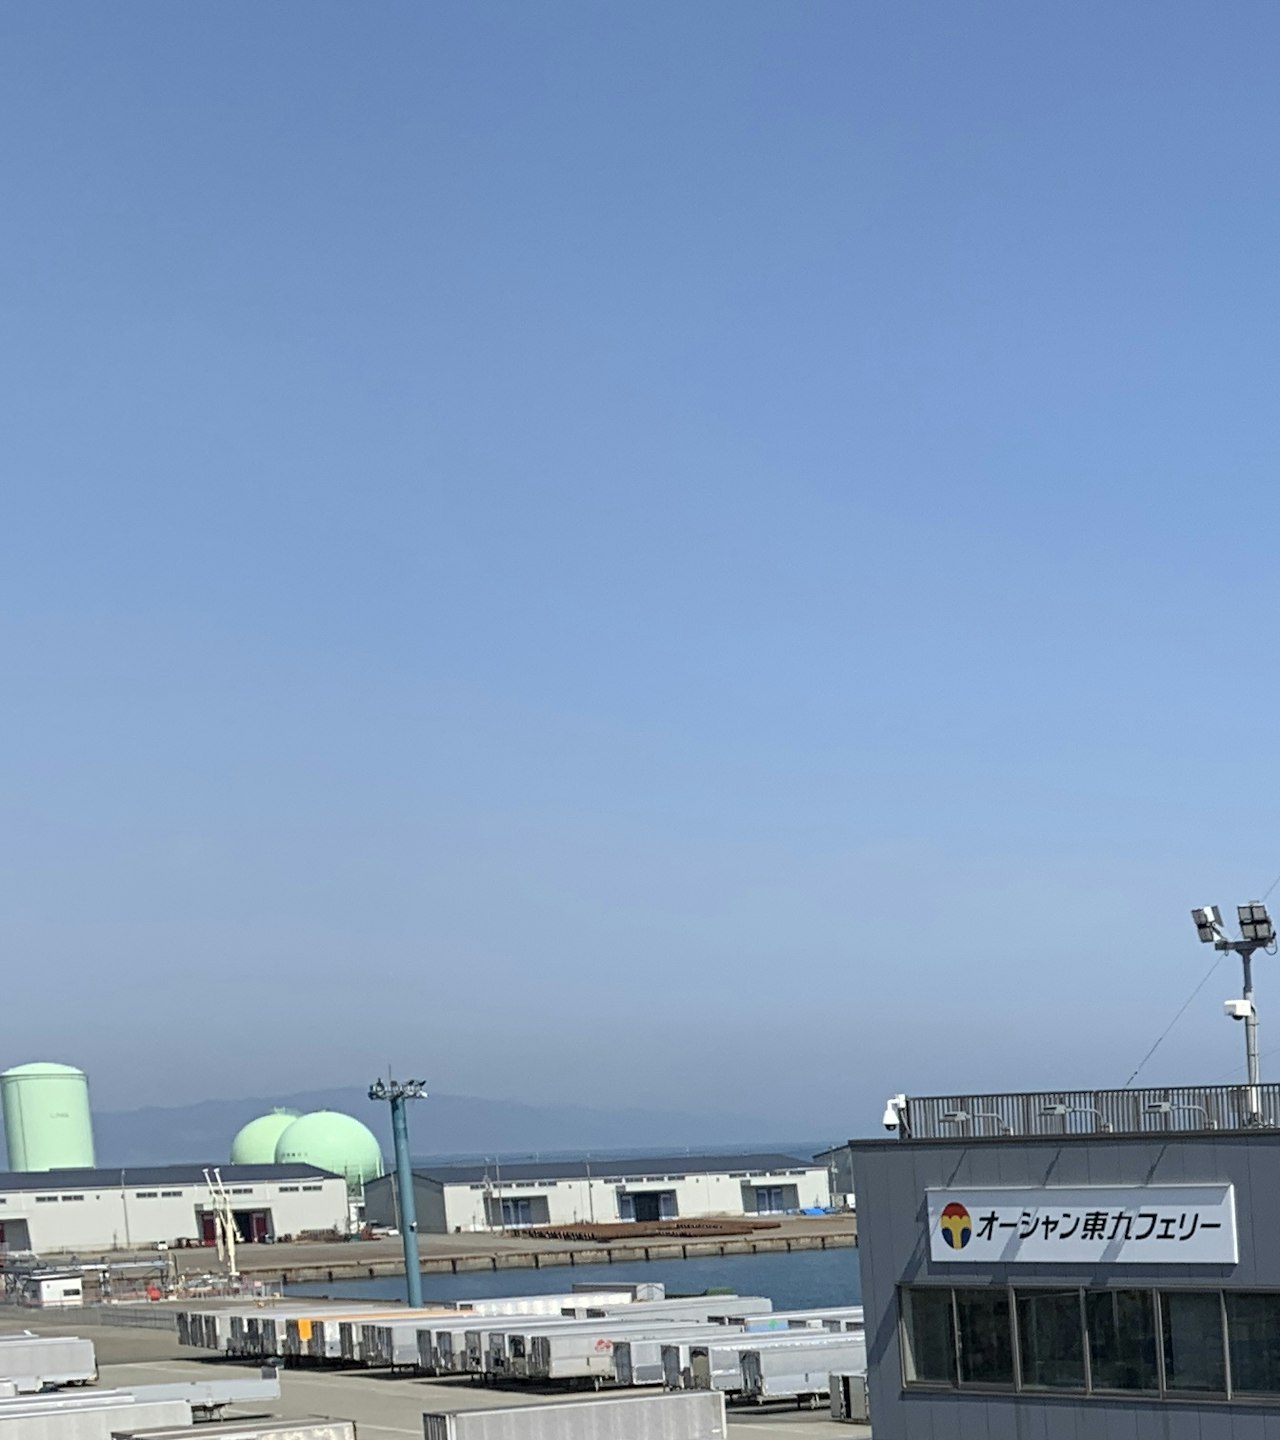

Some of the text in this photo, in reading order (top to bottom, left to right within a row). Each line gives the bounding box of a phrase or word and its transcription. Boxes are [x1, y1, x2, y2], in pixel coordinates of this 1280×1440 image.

[976, 1210, 1222, 1242] オーシャン東九フェリー
